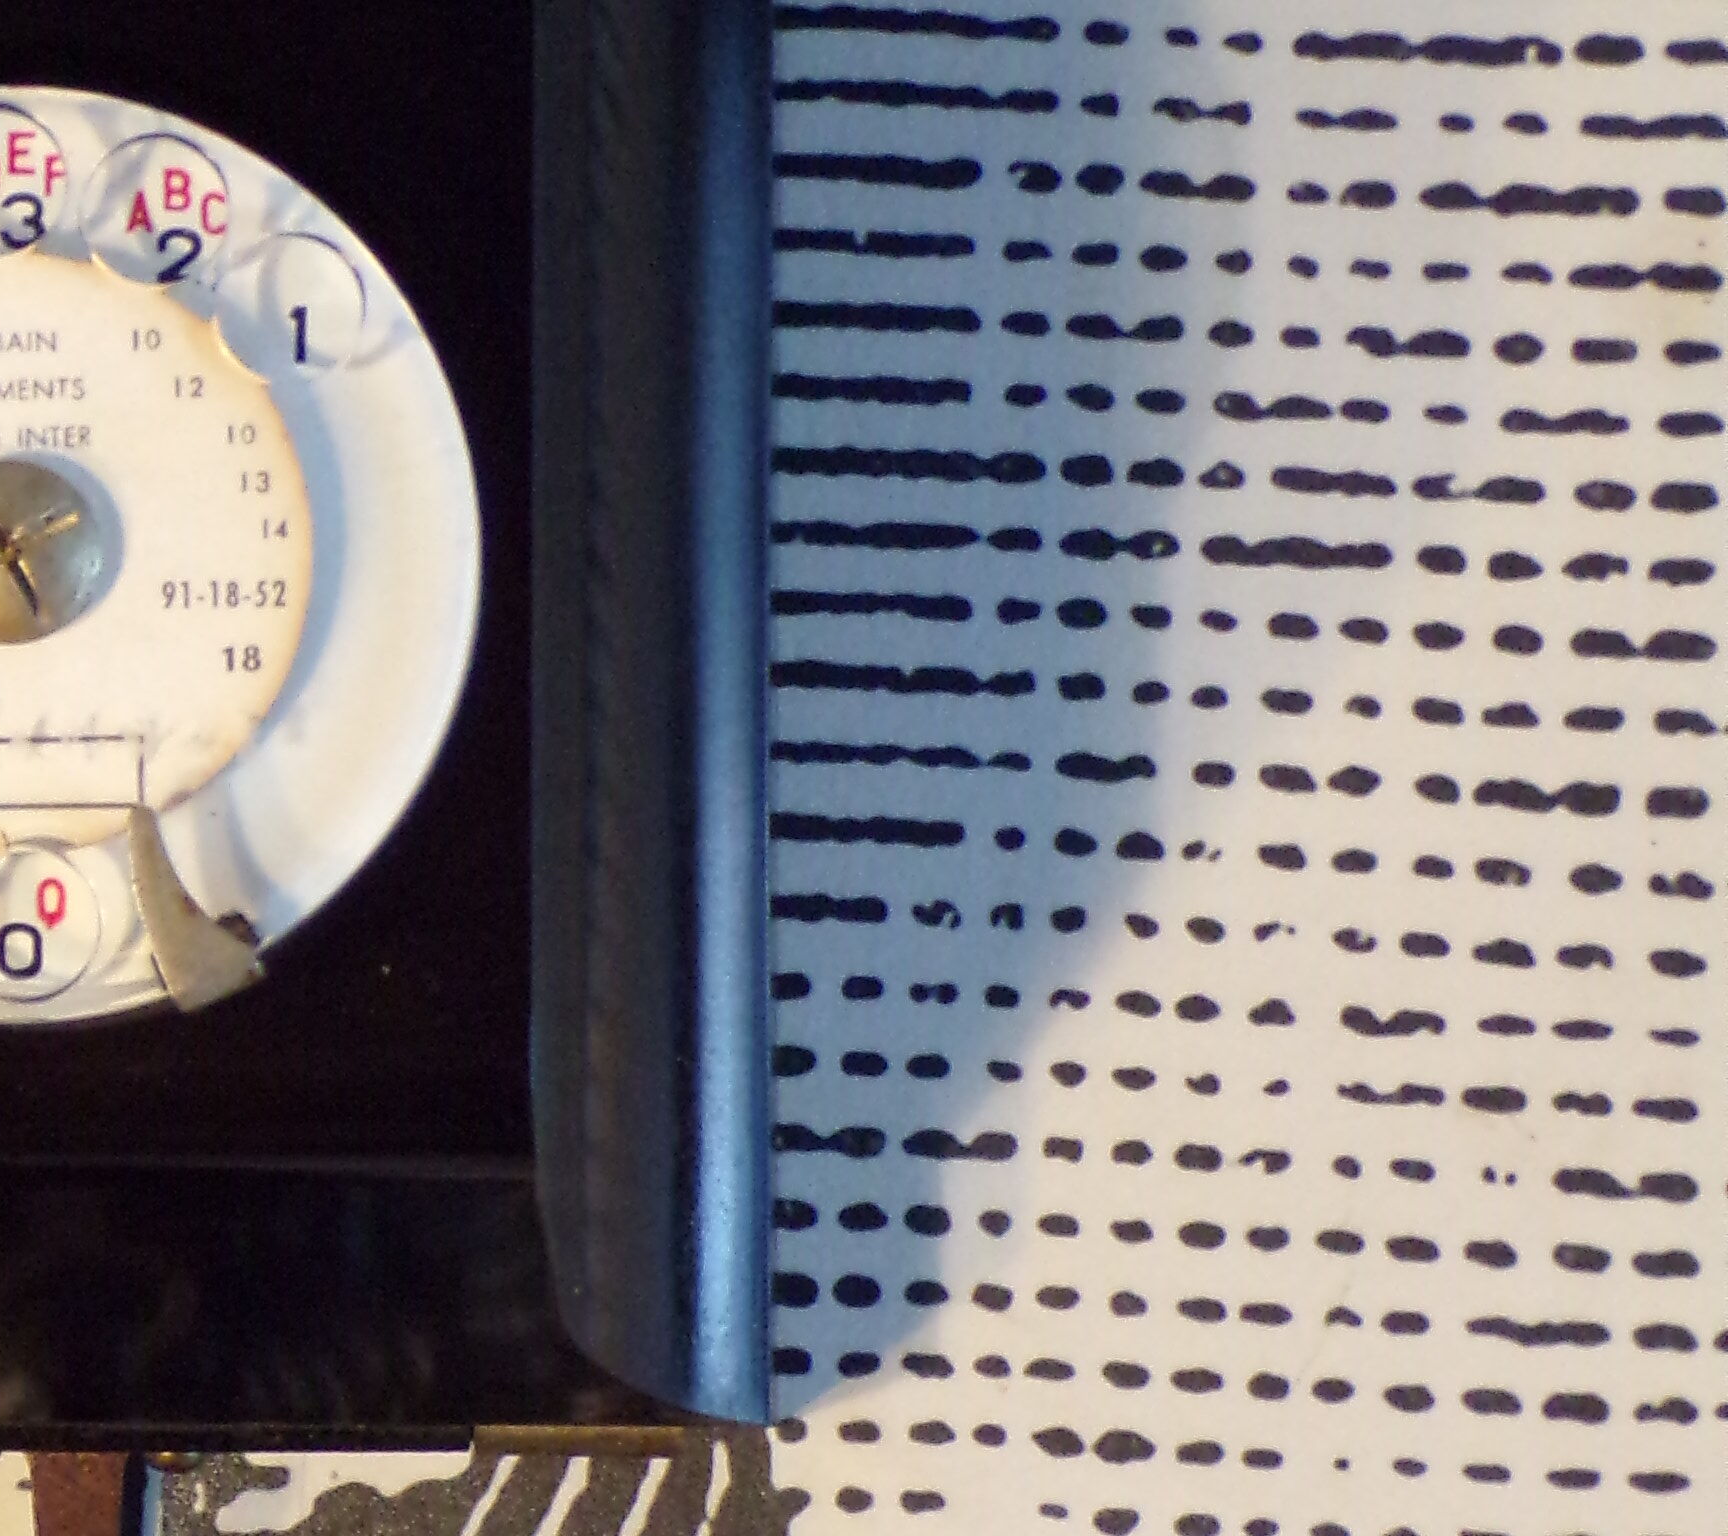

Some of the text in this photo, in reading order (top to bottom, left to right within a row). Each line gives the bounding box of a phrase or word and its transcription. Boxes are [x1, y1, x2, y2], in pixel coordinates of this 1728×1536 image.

[127, 167, 226, 235] ABC
[0, 191, 46, 250] 3
[156, 227, 203, 284] 2
[130, 328, 161, 351] 10
[288, 305, 308, 364] 1
[174, 376, 205, 399] 12
[17, 425, 92, 449] INTER
[227, 424, 257, 445] 10
[240, 470, 271, 493] 13
[262, 518, 289, 540] 14
[161, 578, 288, 609] 91-18-52
[222, 644, 263, 673] 18
